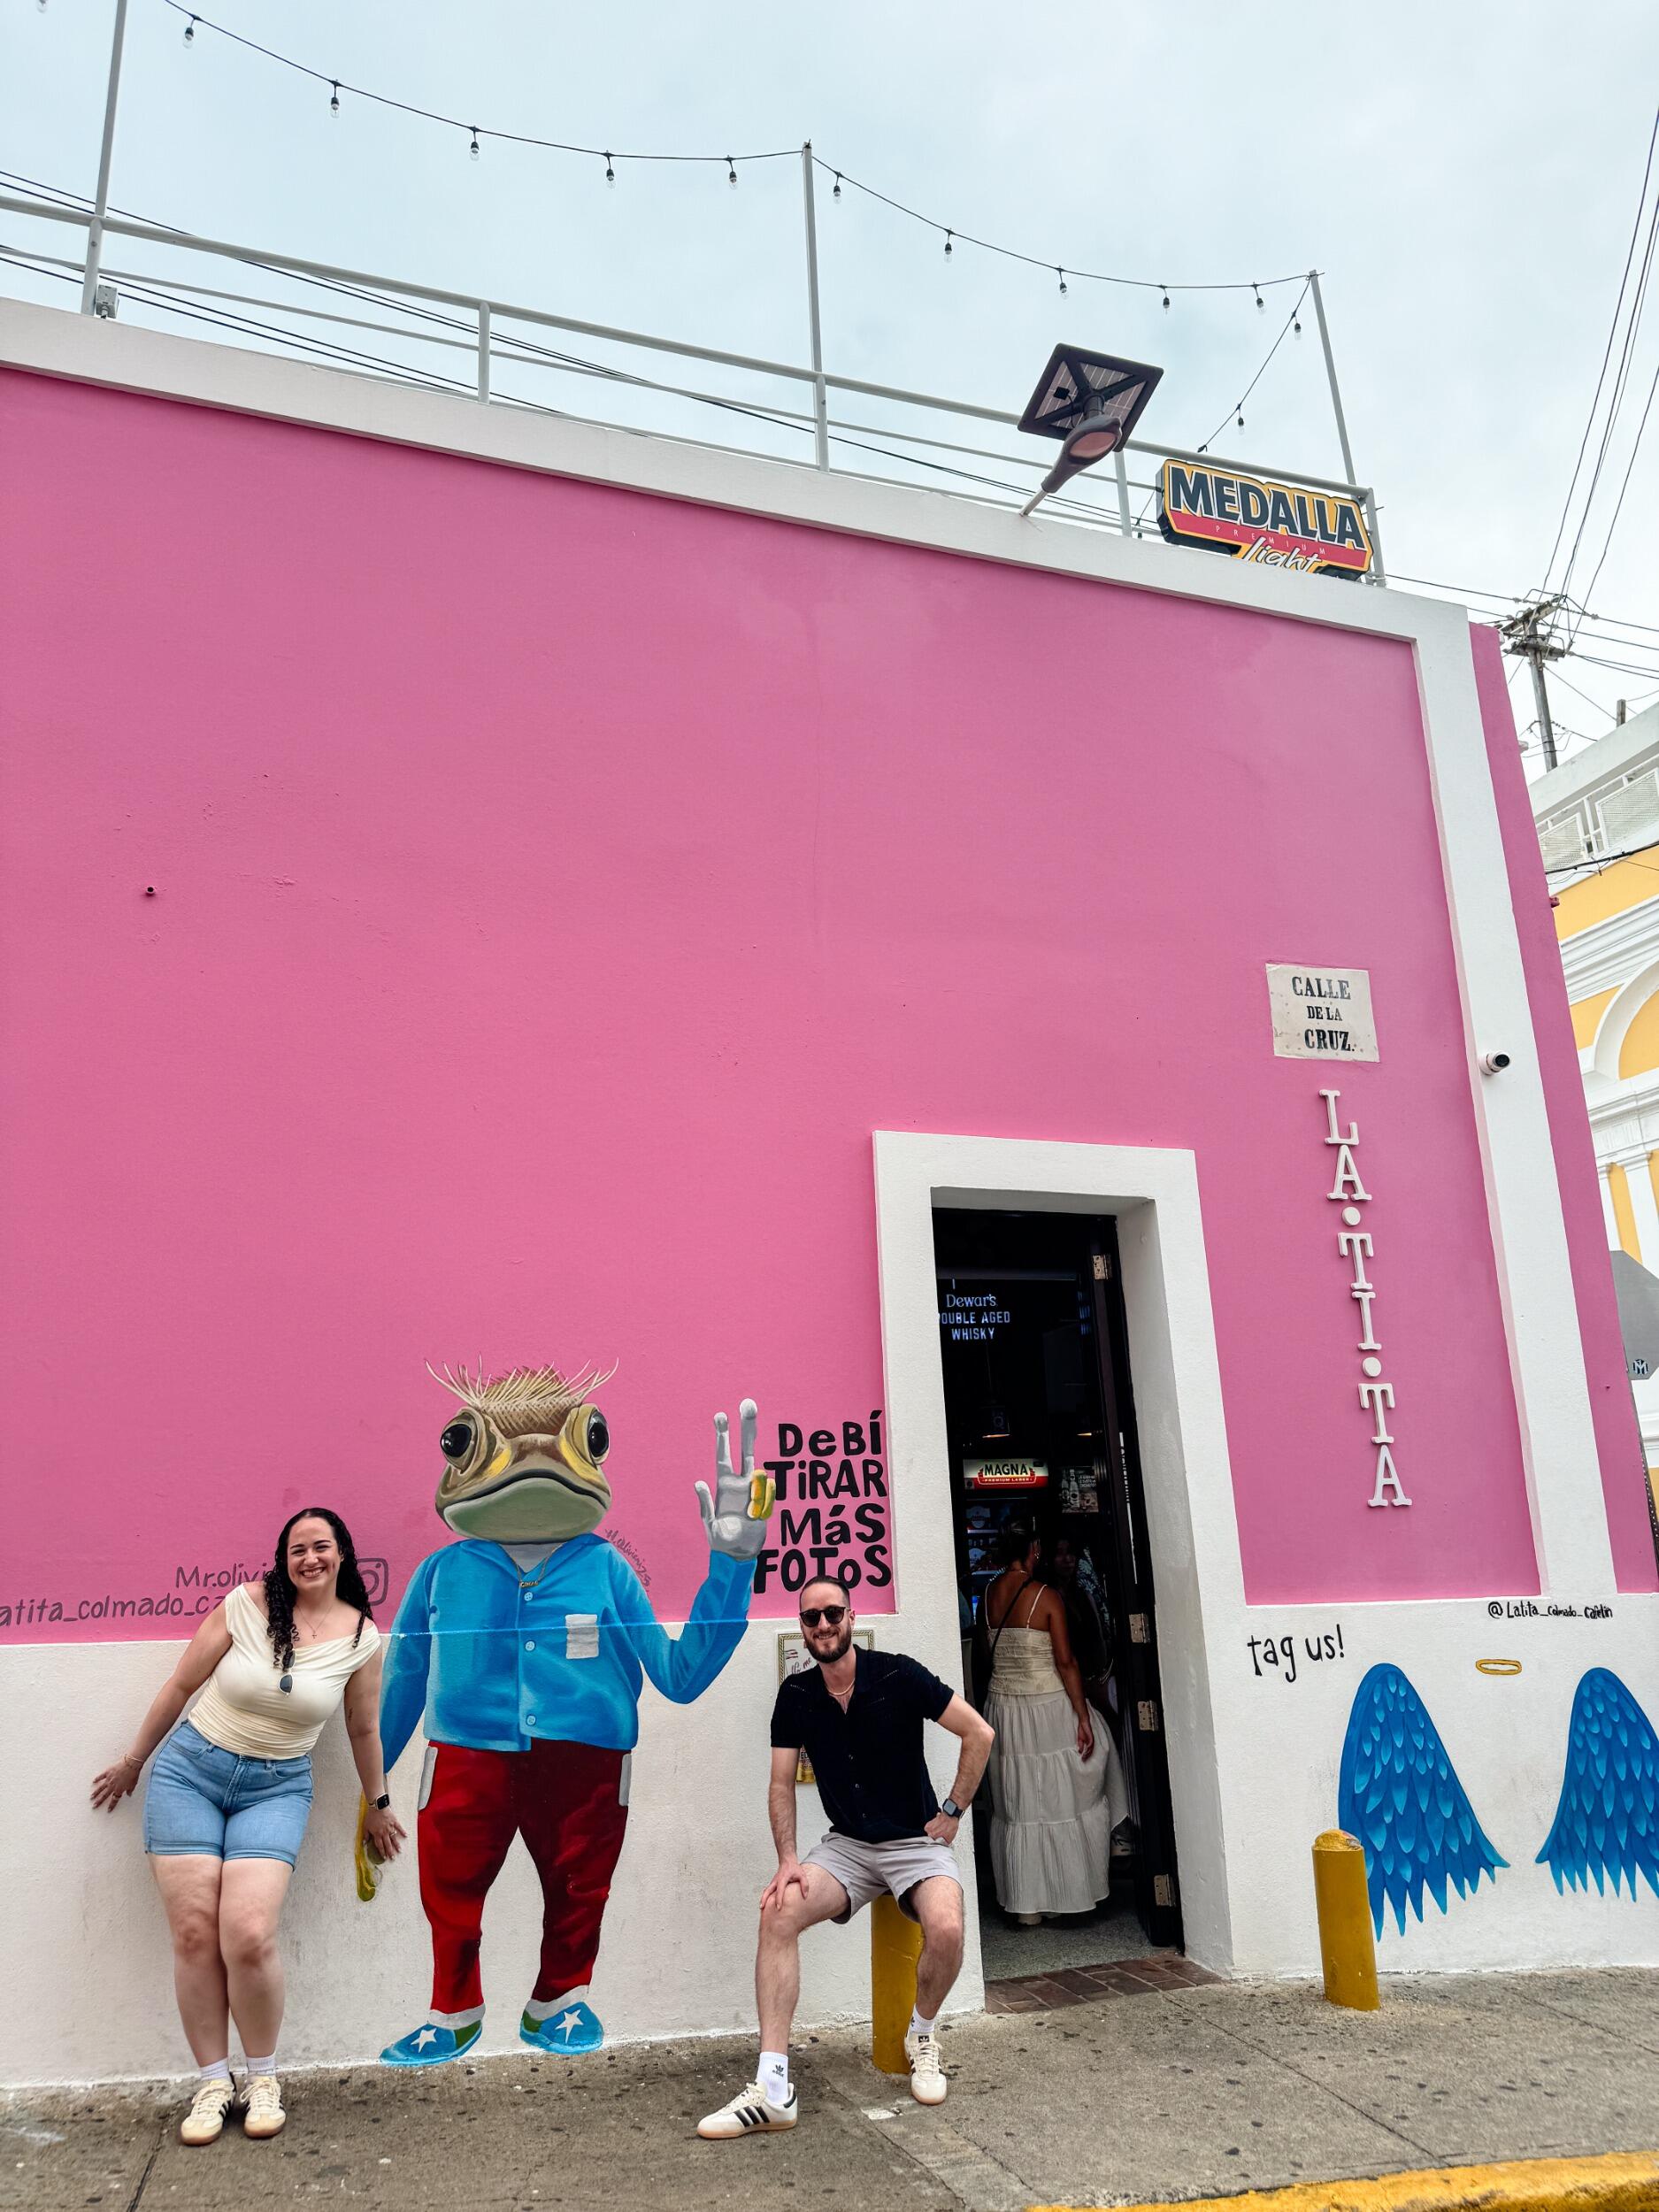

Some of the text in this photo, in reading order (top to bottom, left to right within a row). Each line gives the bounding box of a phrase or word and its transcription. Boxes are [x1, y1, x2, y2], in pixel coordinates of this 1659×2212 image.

[1170, 465, 1367, 550] MEDALLA
[1215, 525, 1326, 556] PREMIUM
[1292, 976, 1351, 1000] CALLE
[1307, 1005, 1343, 1022] DE LA
[1304, 1029, 1356, 1052] CRUZ.
[946, 1294, 997, 1308] Dewar's
[938, 1311, 1010, 1325] OUBLE AGED
[951, 1327, 995, 1341] WHISKY
[984, 1463, 1029, 1477] MAGNA
[176, 1563, 267, 1589] Mr.olivi
[1247, 1624, 1345, 1683] tag us!
